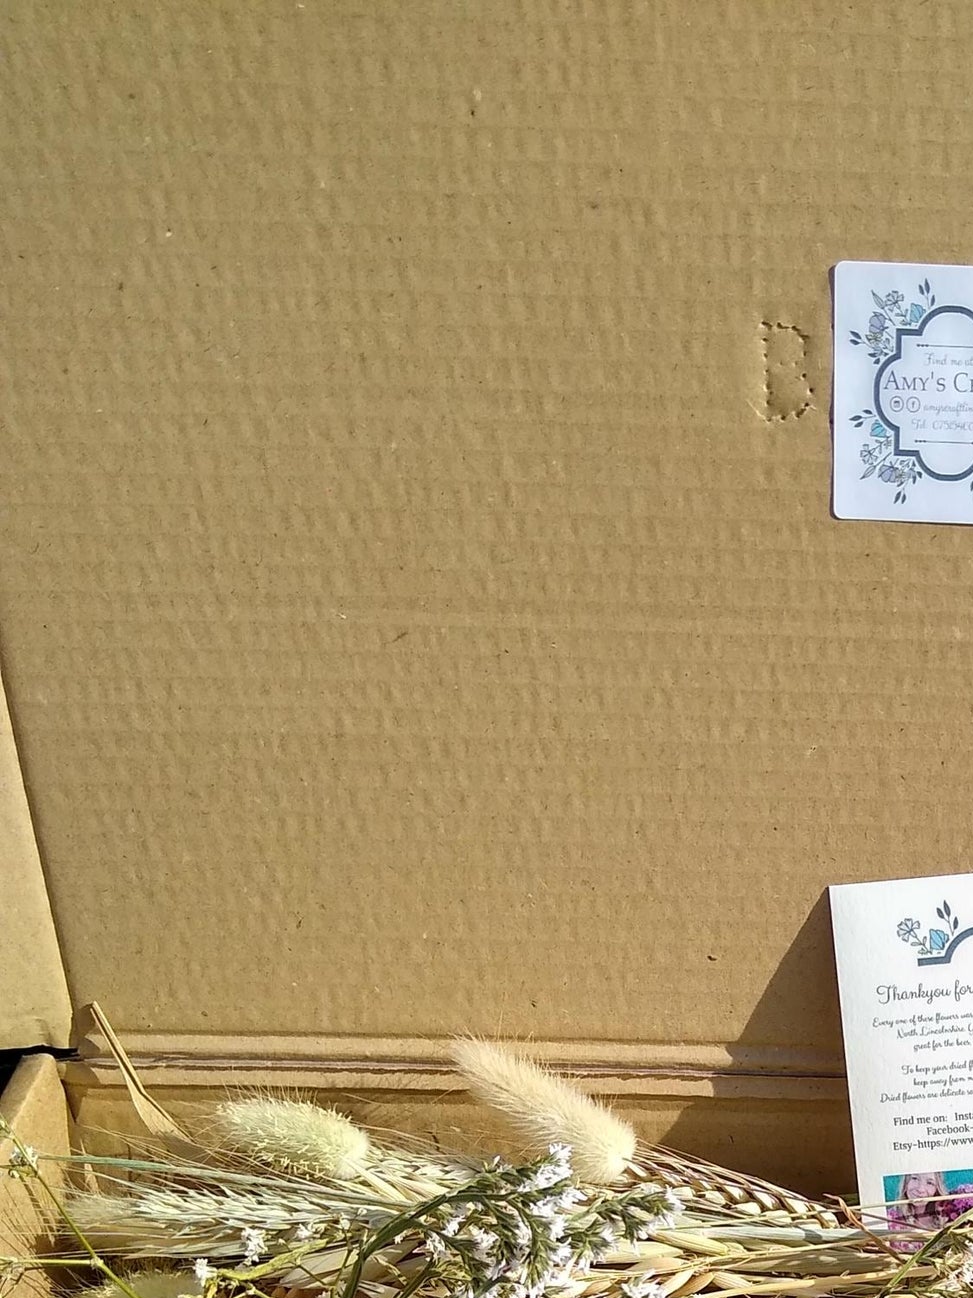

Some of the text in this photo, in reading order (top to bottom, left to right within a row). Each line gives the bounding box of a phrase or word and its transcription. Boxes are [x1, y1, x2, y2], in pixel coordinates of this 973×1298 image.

[924, 352, 947, 366] Find
[951, 358, 962, 366] me
[876, 983, 951, 1005] Thankyou
[872, 1017, 893, 1028] Every
[909, 1015, 916, 1025] of
[917, 1014, 934, 1023] these
[935, 1012, 960, 1024] flowers
[897, 1028, 918, 1039] North
[913, 1041, 931, 1052] great
[932, 1040, 943, 1051] for
[944, 1038, 954, 1047] the
[901, 1064, 914, 1075] To
[915, 1064, 931, 1075] keep
[932, 1065, 948, 1074] your
[949, 1060, 967, 1071] dried
[913, 1077, 929, 1088] keep
[930, 1079, 947, 1087] away
[949, 1075, 966, 1086] from
[880, 1092, 901, 1103] Dried
[902, 1092, 926, 1103] flowers
[939, 1088, 966, 1098] delicate
[893, 1115, 914, 1126] Find
[916, 1117, 931, 1125] me
[933, 1115, 948, 1123] on:
